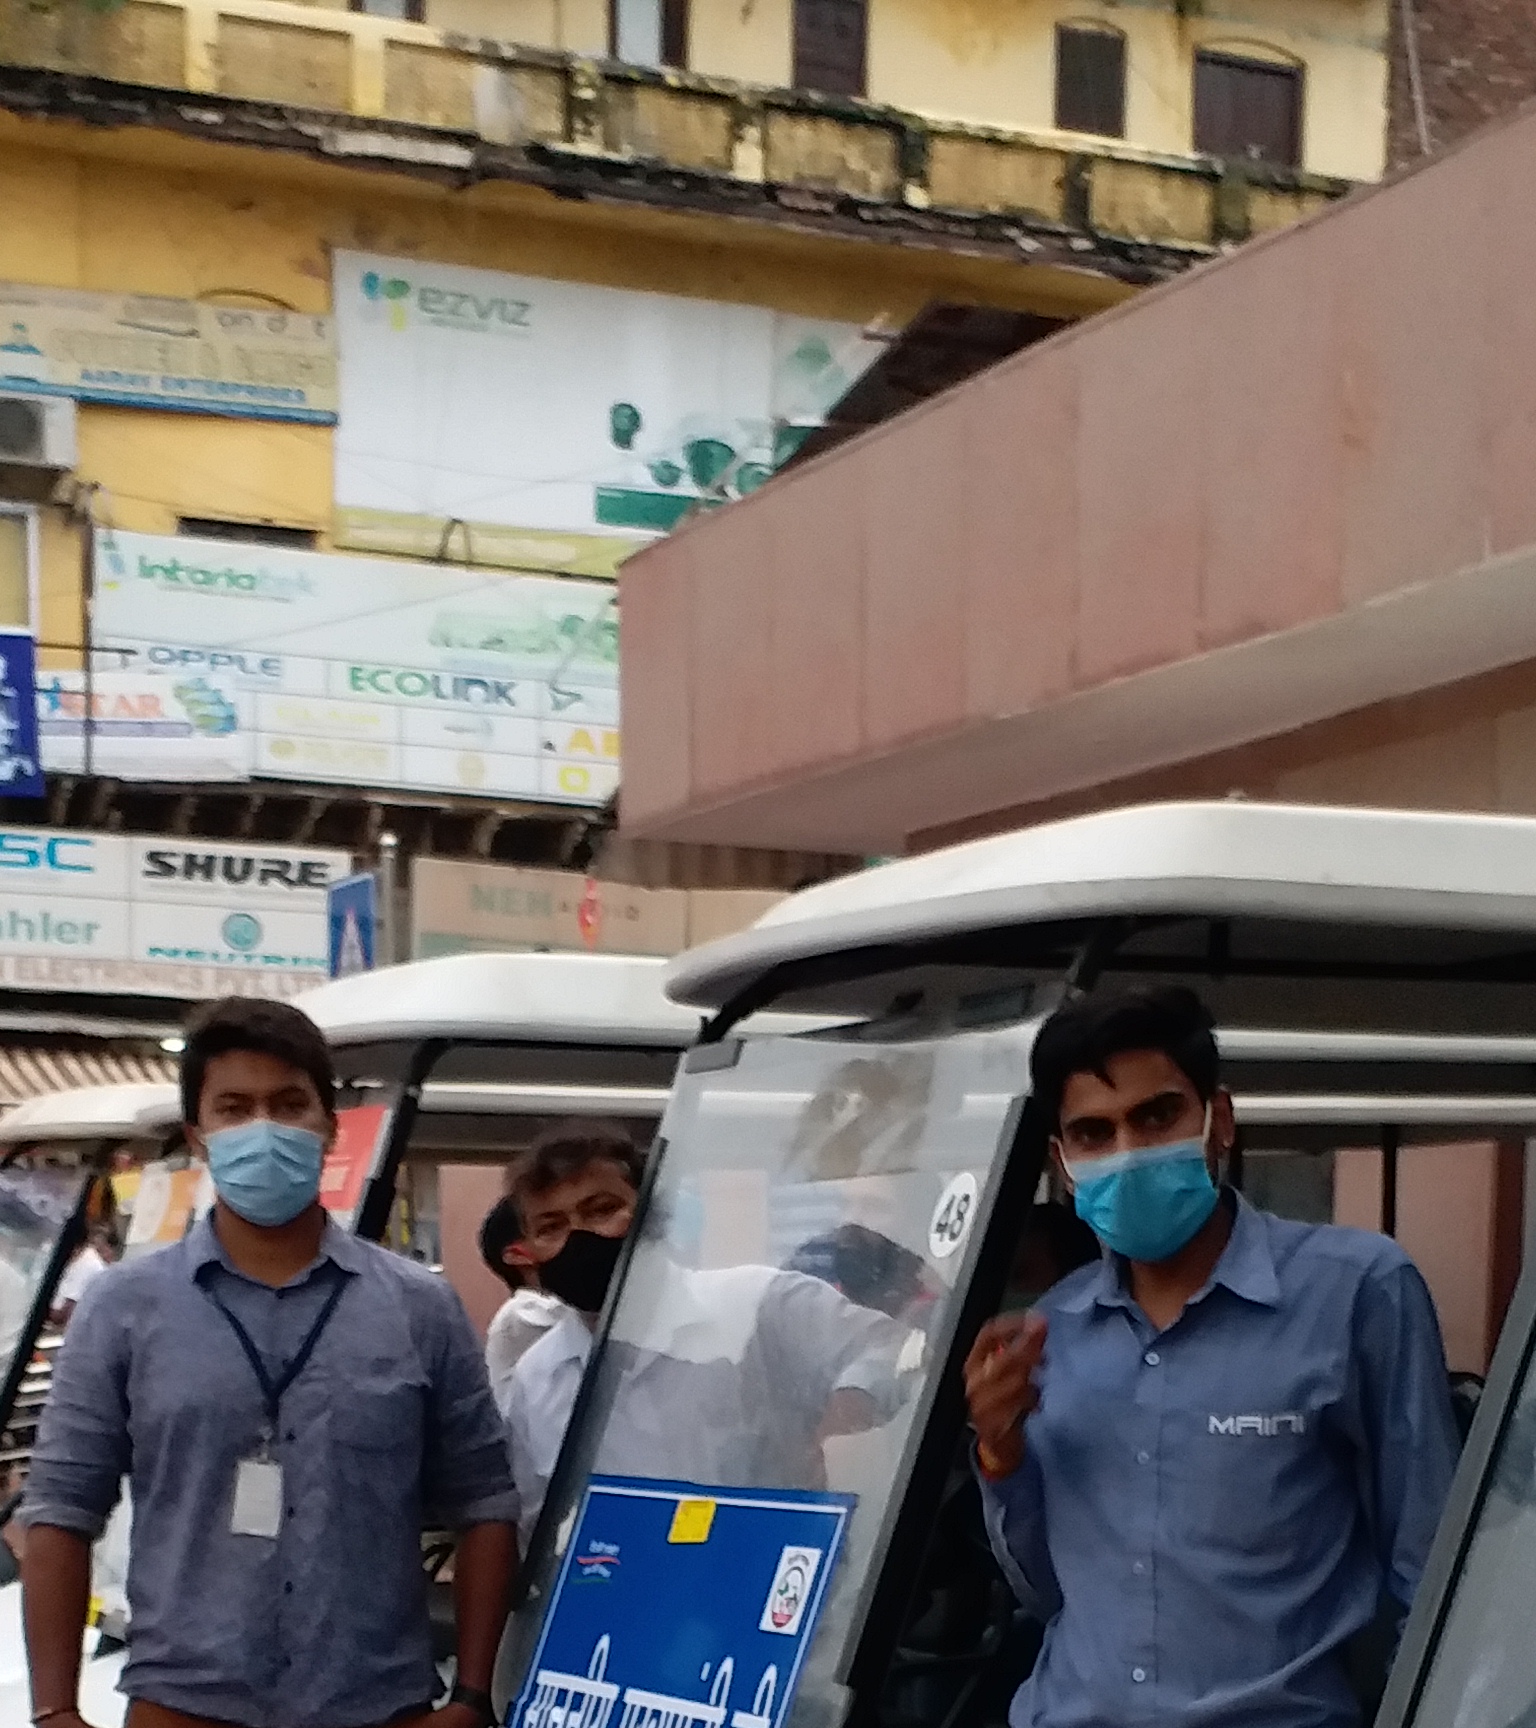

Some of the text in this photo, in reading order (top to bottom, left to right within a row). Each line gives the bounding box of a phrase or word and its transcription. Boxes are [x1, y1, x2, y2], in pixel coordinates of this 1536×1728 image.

[349, 664, 518, 708] ECOLINK
[142, 849, 332, 891] SHURE
[935, 1192, 971, 1243] 48
[1208, 1415, 1304, 1436] MAINI
